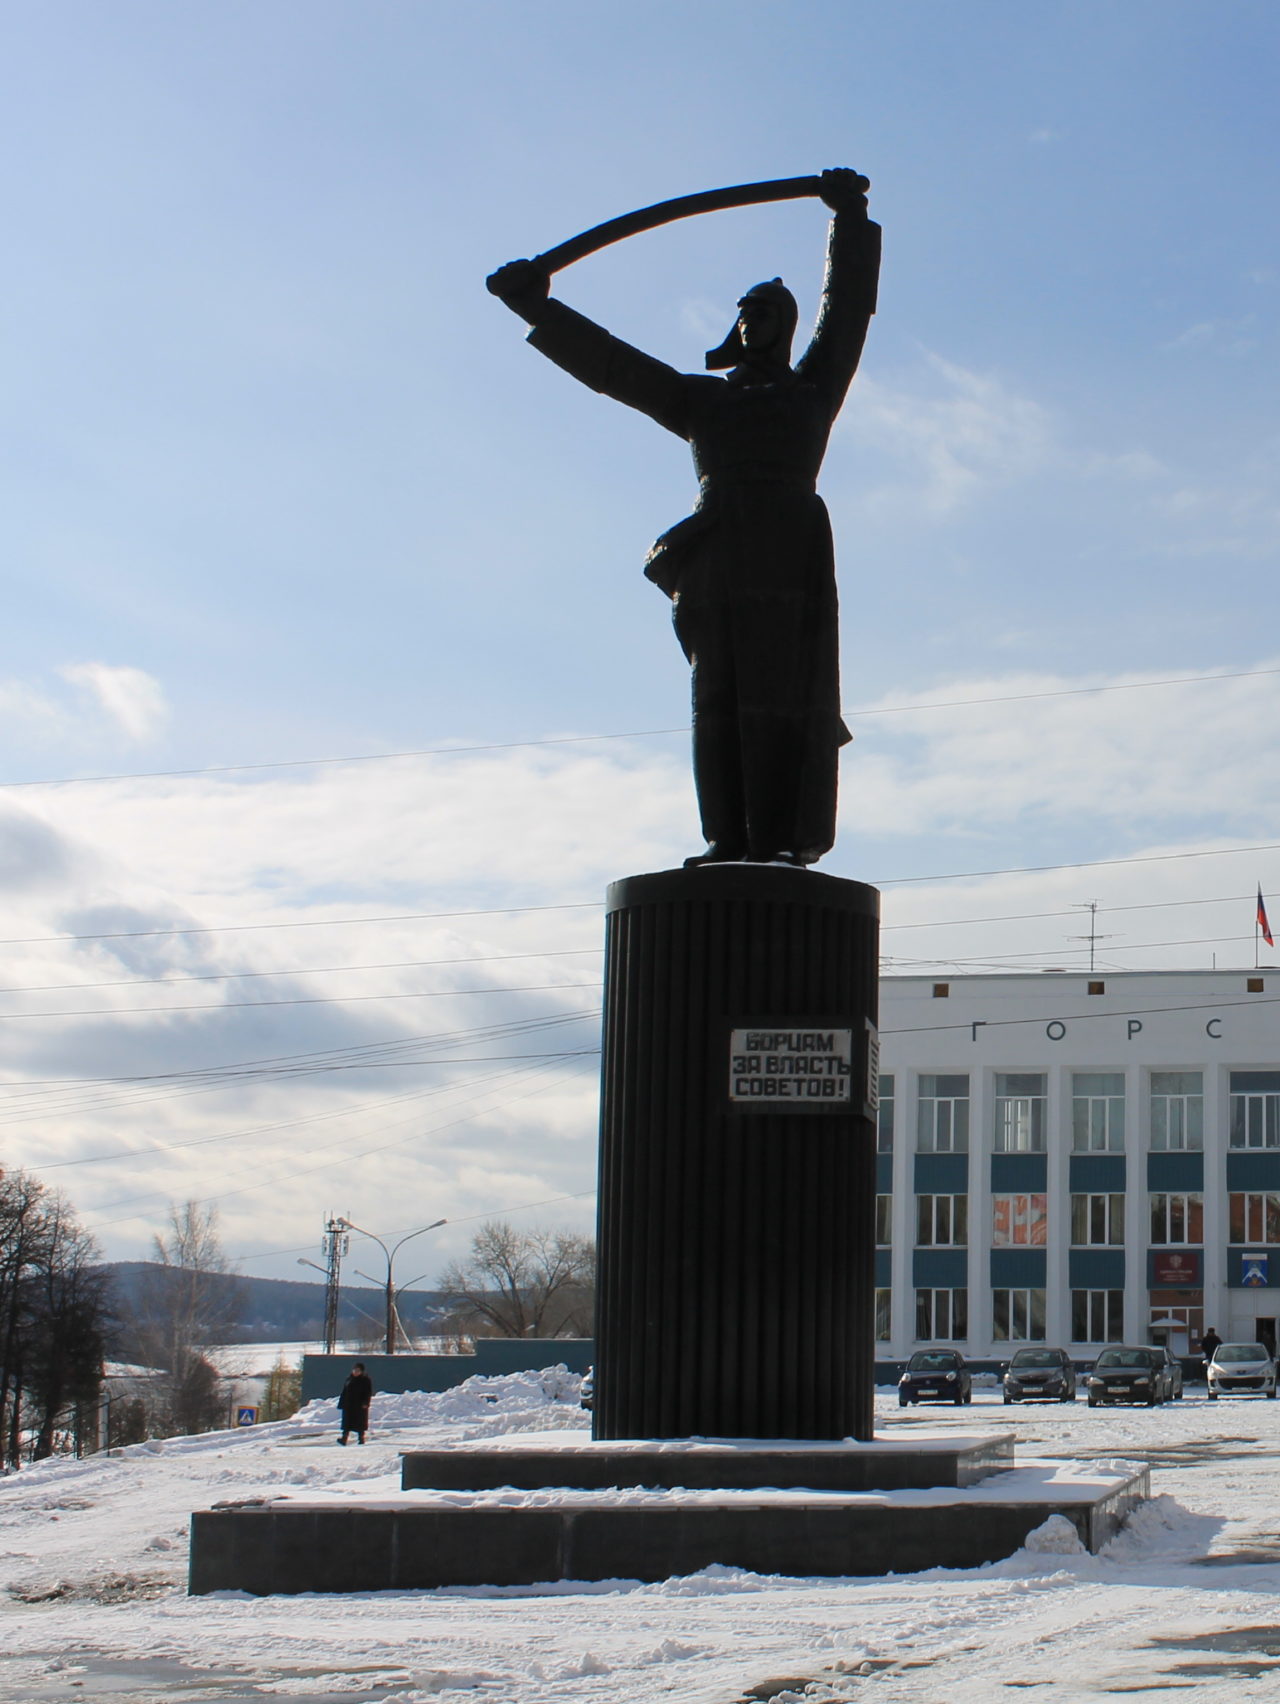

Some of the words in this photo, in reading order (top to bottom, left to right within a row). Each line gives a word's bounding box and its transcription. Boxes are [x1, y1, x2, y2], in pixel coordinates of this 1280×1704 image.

[746, 1032, 834, 1052] БОРЦАМ
[733, 1056, 761, 1074] ЗА
[766, 1056, 850, 1075] ВЛАСТЬ
[735, 1078, 844, 1096] СОВЕТОВ!
